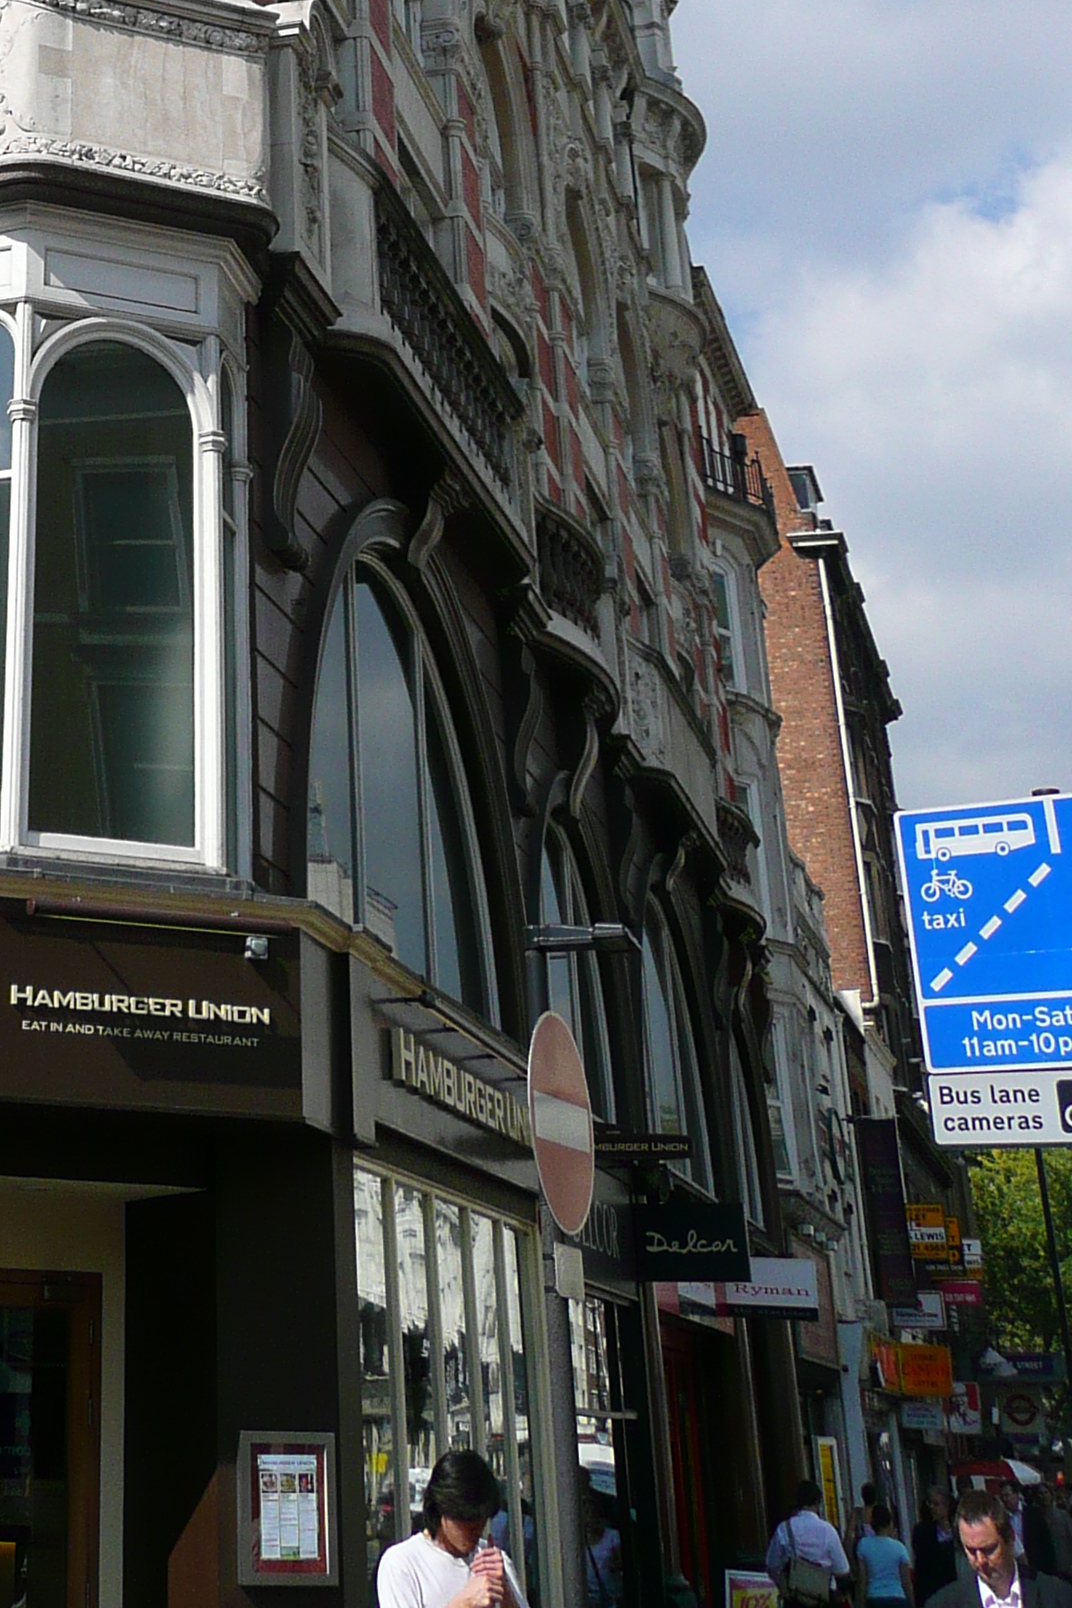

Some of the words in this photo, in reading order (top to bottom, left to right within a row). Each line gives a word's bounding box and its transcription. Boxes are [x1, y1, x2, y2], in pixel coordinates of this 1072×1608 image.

[921, 908, 967, 930] taxi
[10, 984, 183, 1018] HAMBURGER
[188, 999, 271, 1025] UNION
[21, 1020, 48, 1032] EAT
[50, 1022, 63, 1033] IN
[65, 1023, 95, 1035] AND
[96, 1025, 132, 1038] TAKE
[133, 1029, 171, 1041] AWAY
[173, 1031, 260, 1047] RESTAURANT
[392, 1027, 507, 1135] HAMBURGER
[939, 1085, 981, 1105] Bus
[990, 1084, 1041, 1104] lane
[943, 1113, 1044, 1132] cameras
[593, 1142, 650, 1151] MBURGER
[651, 1142, 689, 1152] UNION
[573, 1200, 621, 1260] LCOR
[914, 1232, 945, 1241] LEWIS
[734, 1282, 811, 1298] Ryman
